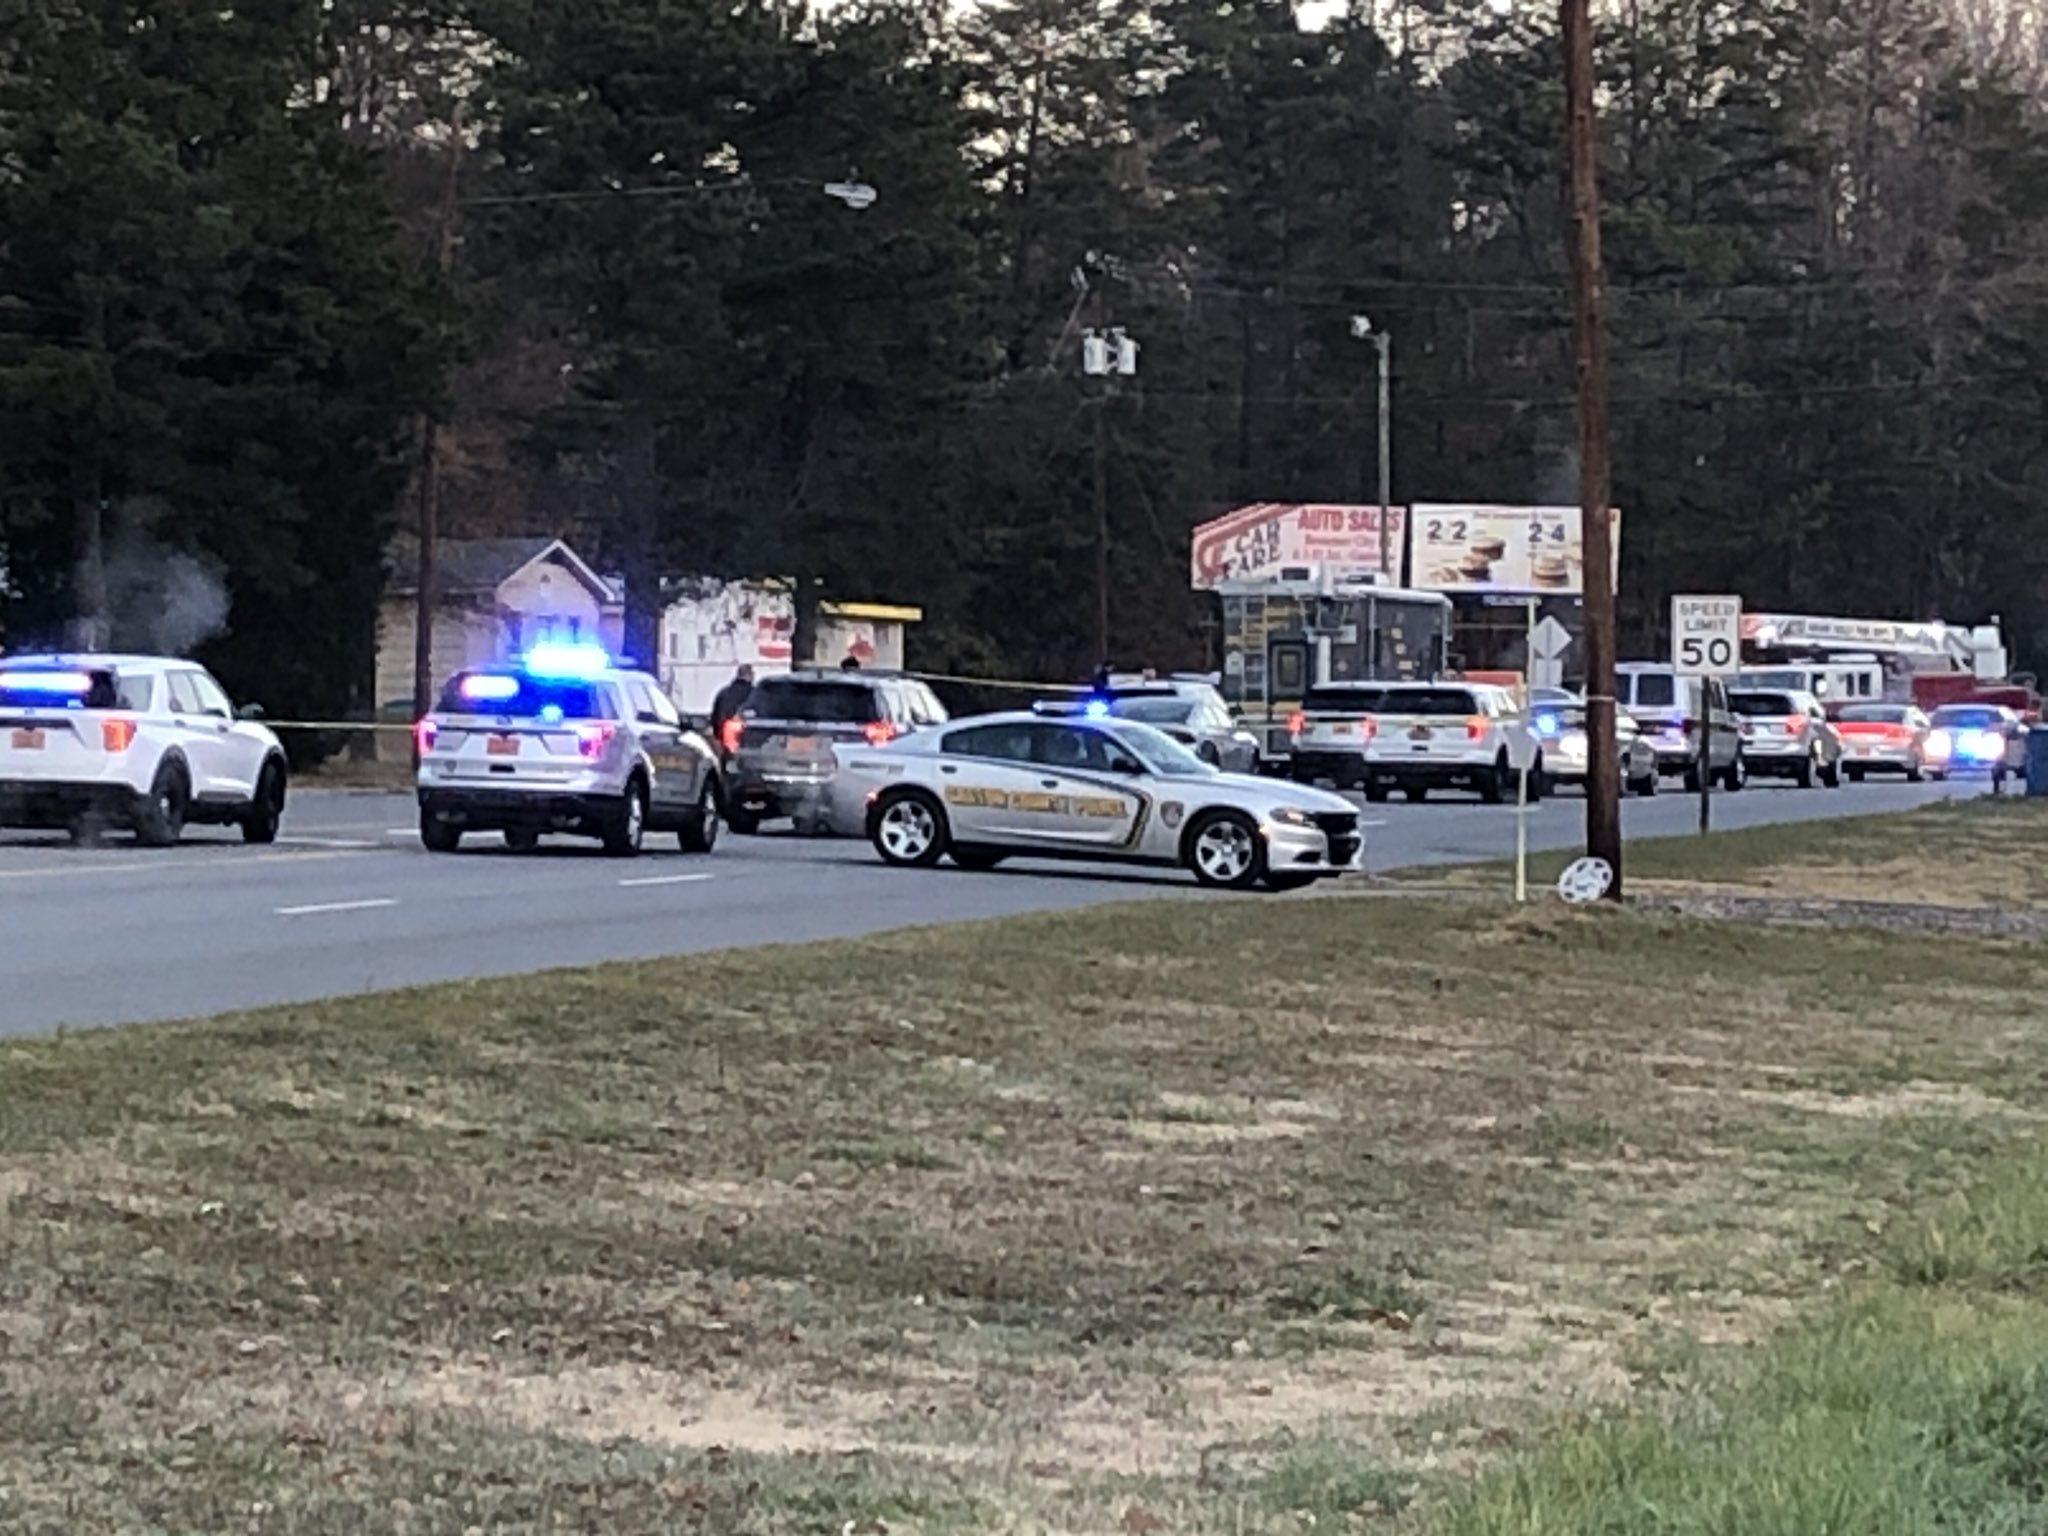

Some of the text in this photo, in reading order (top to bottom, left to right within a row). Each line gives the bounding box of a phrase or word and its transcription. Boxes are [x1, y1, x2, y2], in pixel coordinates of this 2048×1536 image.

[1297, 509, 1401, 532] AUTO SALS
[1427, 519, 1467, 540] 2 2
[1528, 523, 1566, 543] 2 4
[1680, 603, 1736, 616] SPEED
[1684, 618, 1728, 631] LIMIT
[1681, 638, 1731, 667] 50
